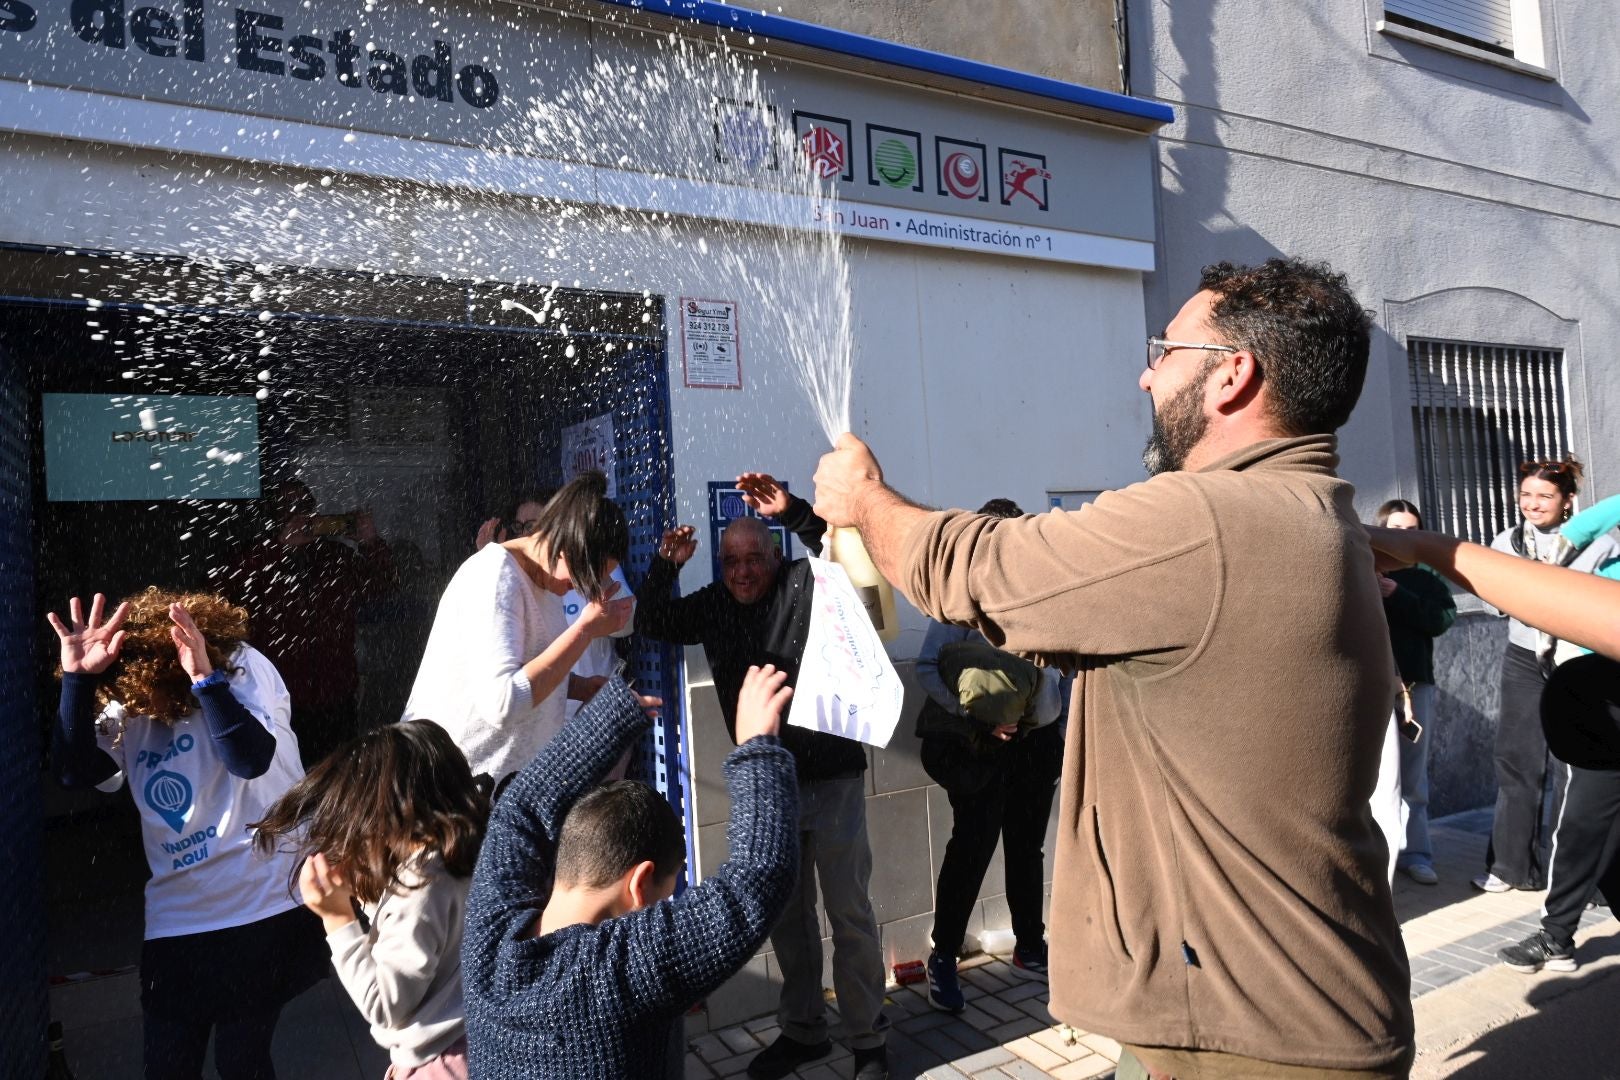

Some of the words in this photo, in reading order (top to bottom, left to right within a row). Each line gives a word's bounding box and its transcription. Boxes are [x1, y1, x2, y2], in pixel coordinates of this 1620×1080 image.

[70, 0, 205, 62] del
[235, 8, 499, 109] Estado
[850, 210, 889, 231] Juan
[905, 217, 1022, 248] Administración
[1046, 236, 1053, 251] 1
[703, 322, 716, 331] 312
[717, 323, 730, 332] 739
[172, 843, 209, 870] AQUÍ
